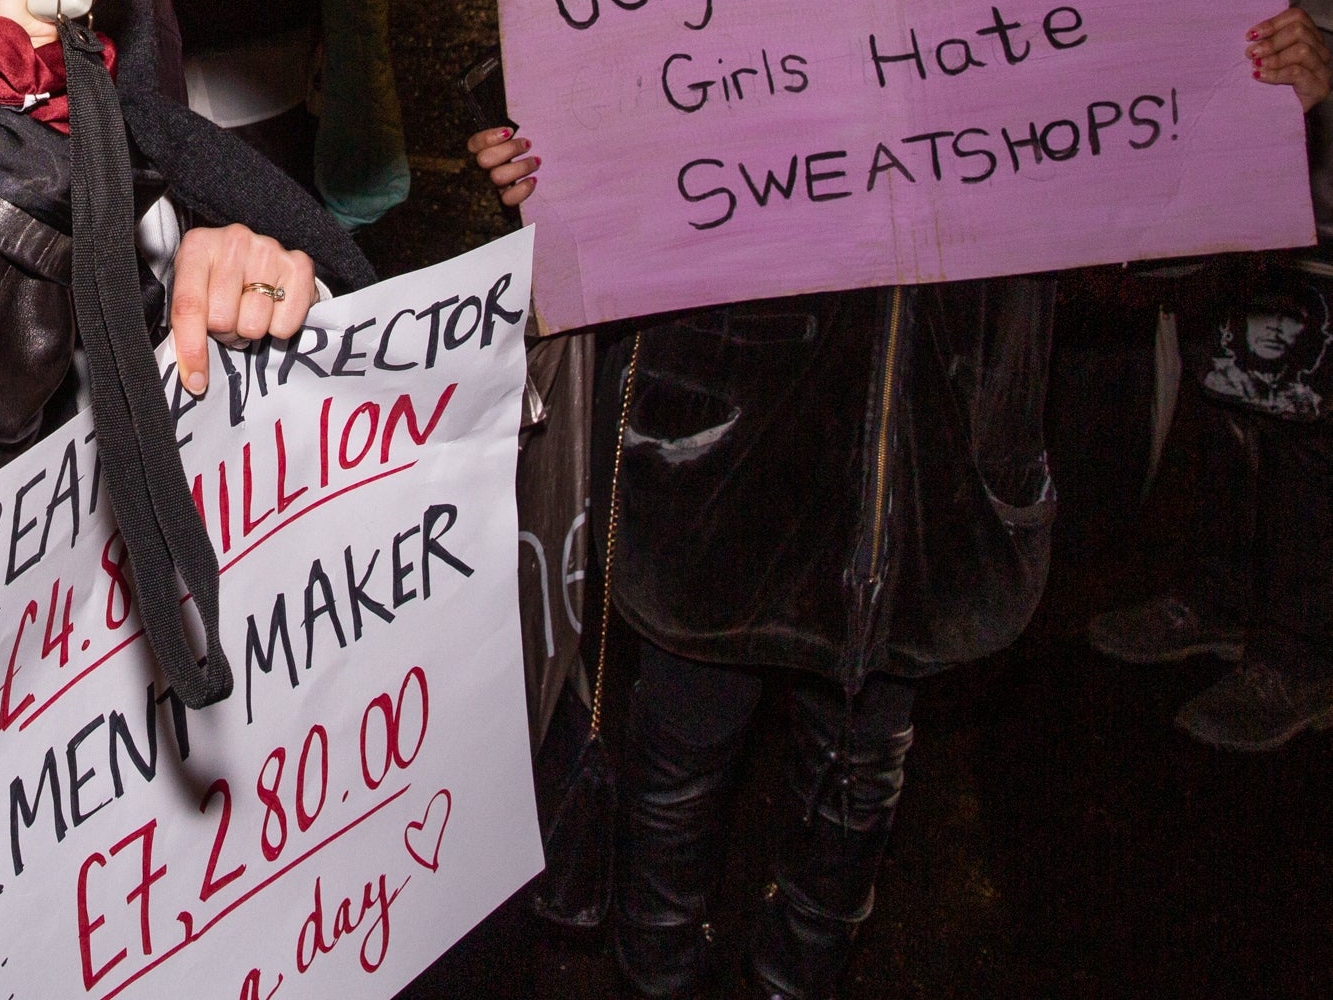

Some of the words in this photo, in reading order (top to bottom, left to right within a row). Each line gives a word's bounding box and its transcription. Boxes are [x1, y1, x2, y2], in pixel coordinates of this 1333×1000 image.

[660, 49, 809, 113] Girls
[869, 5, 1088, 88] Hate
[677, 89, 1179, 230] SWEATSHOPS!
[247, 504, 474, 724] MAKER
[77, 666, 429, 991] £7,280.00
[297, 875, 411, 974] day
